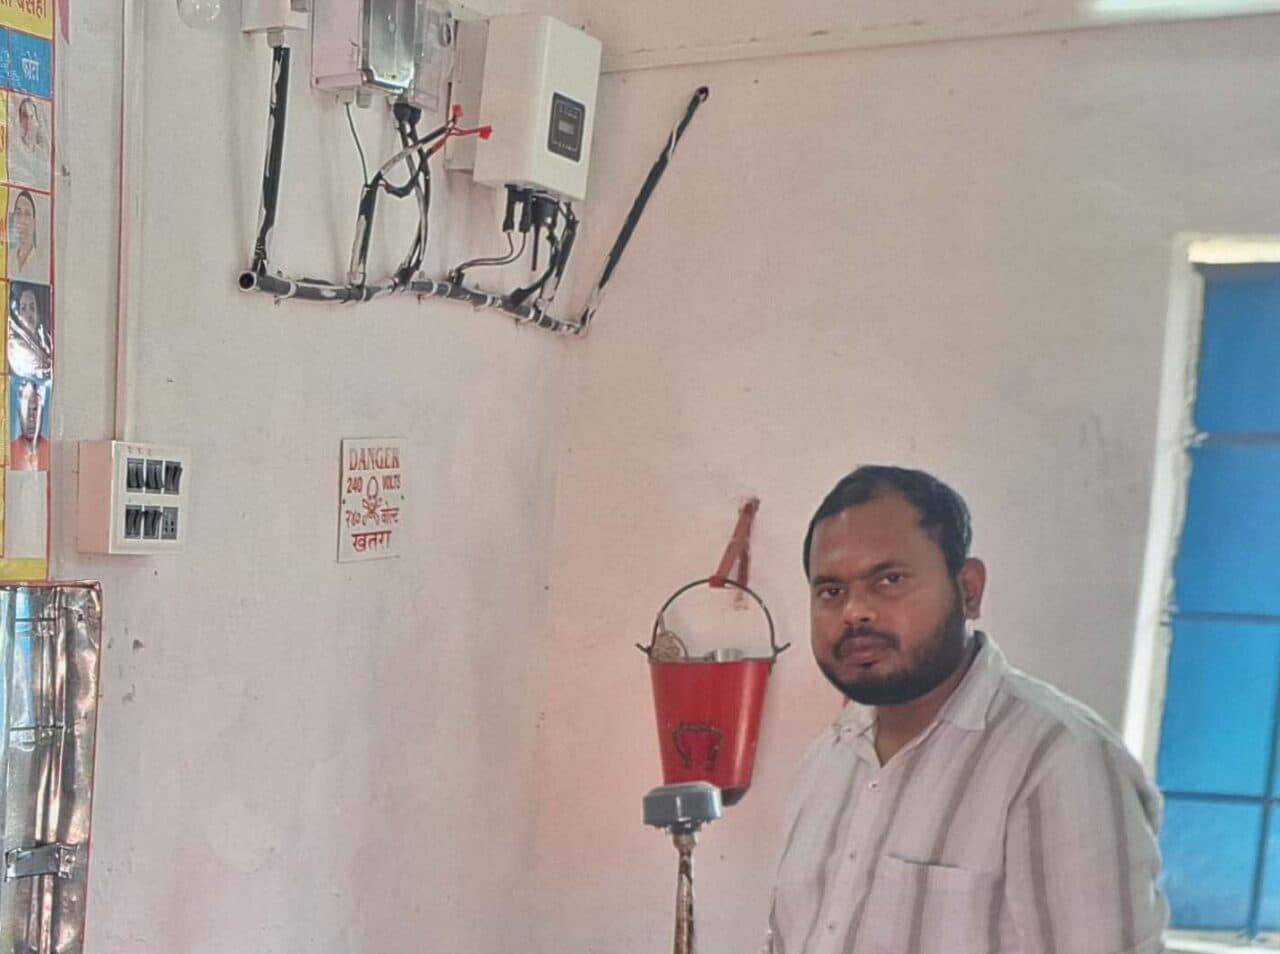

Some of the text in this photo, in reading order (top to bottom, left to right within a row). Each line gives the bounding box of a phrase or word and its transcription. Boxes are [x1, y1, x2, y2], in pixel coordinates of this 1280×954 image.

[349, 447, 400, 470] DANGER
[347, 475, 363, 493] 240
[351, 530, 392, 552] खतरा
